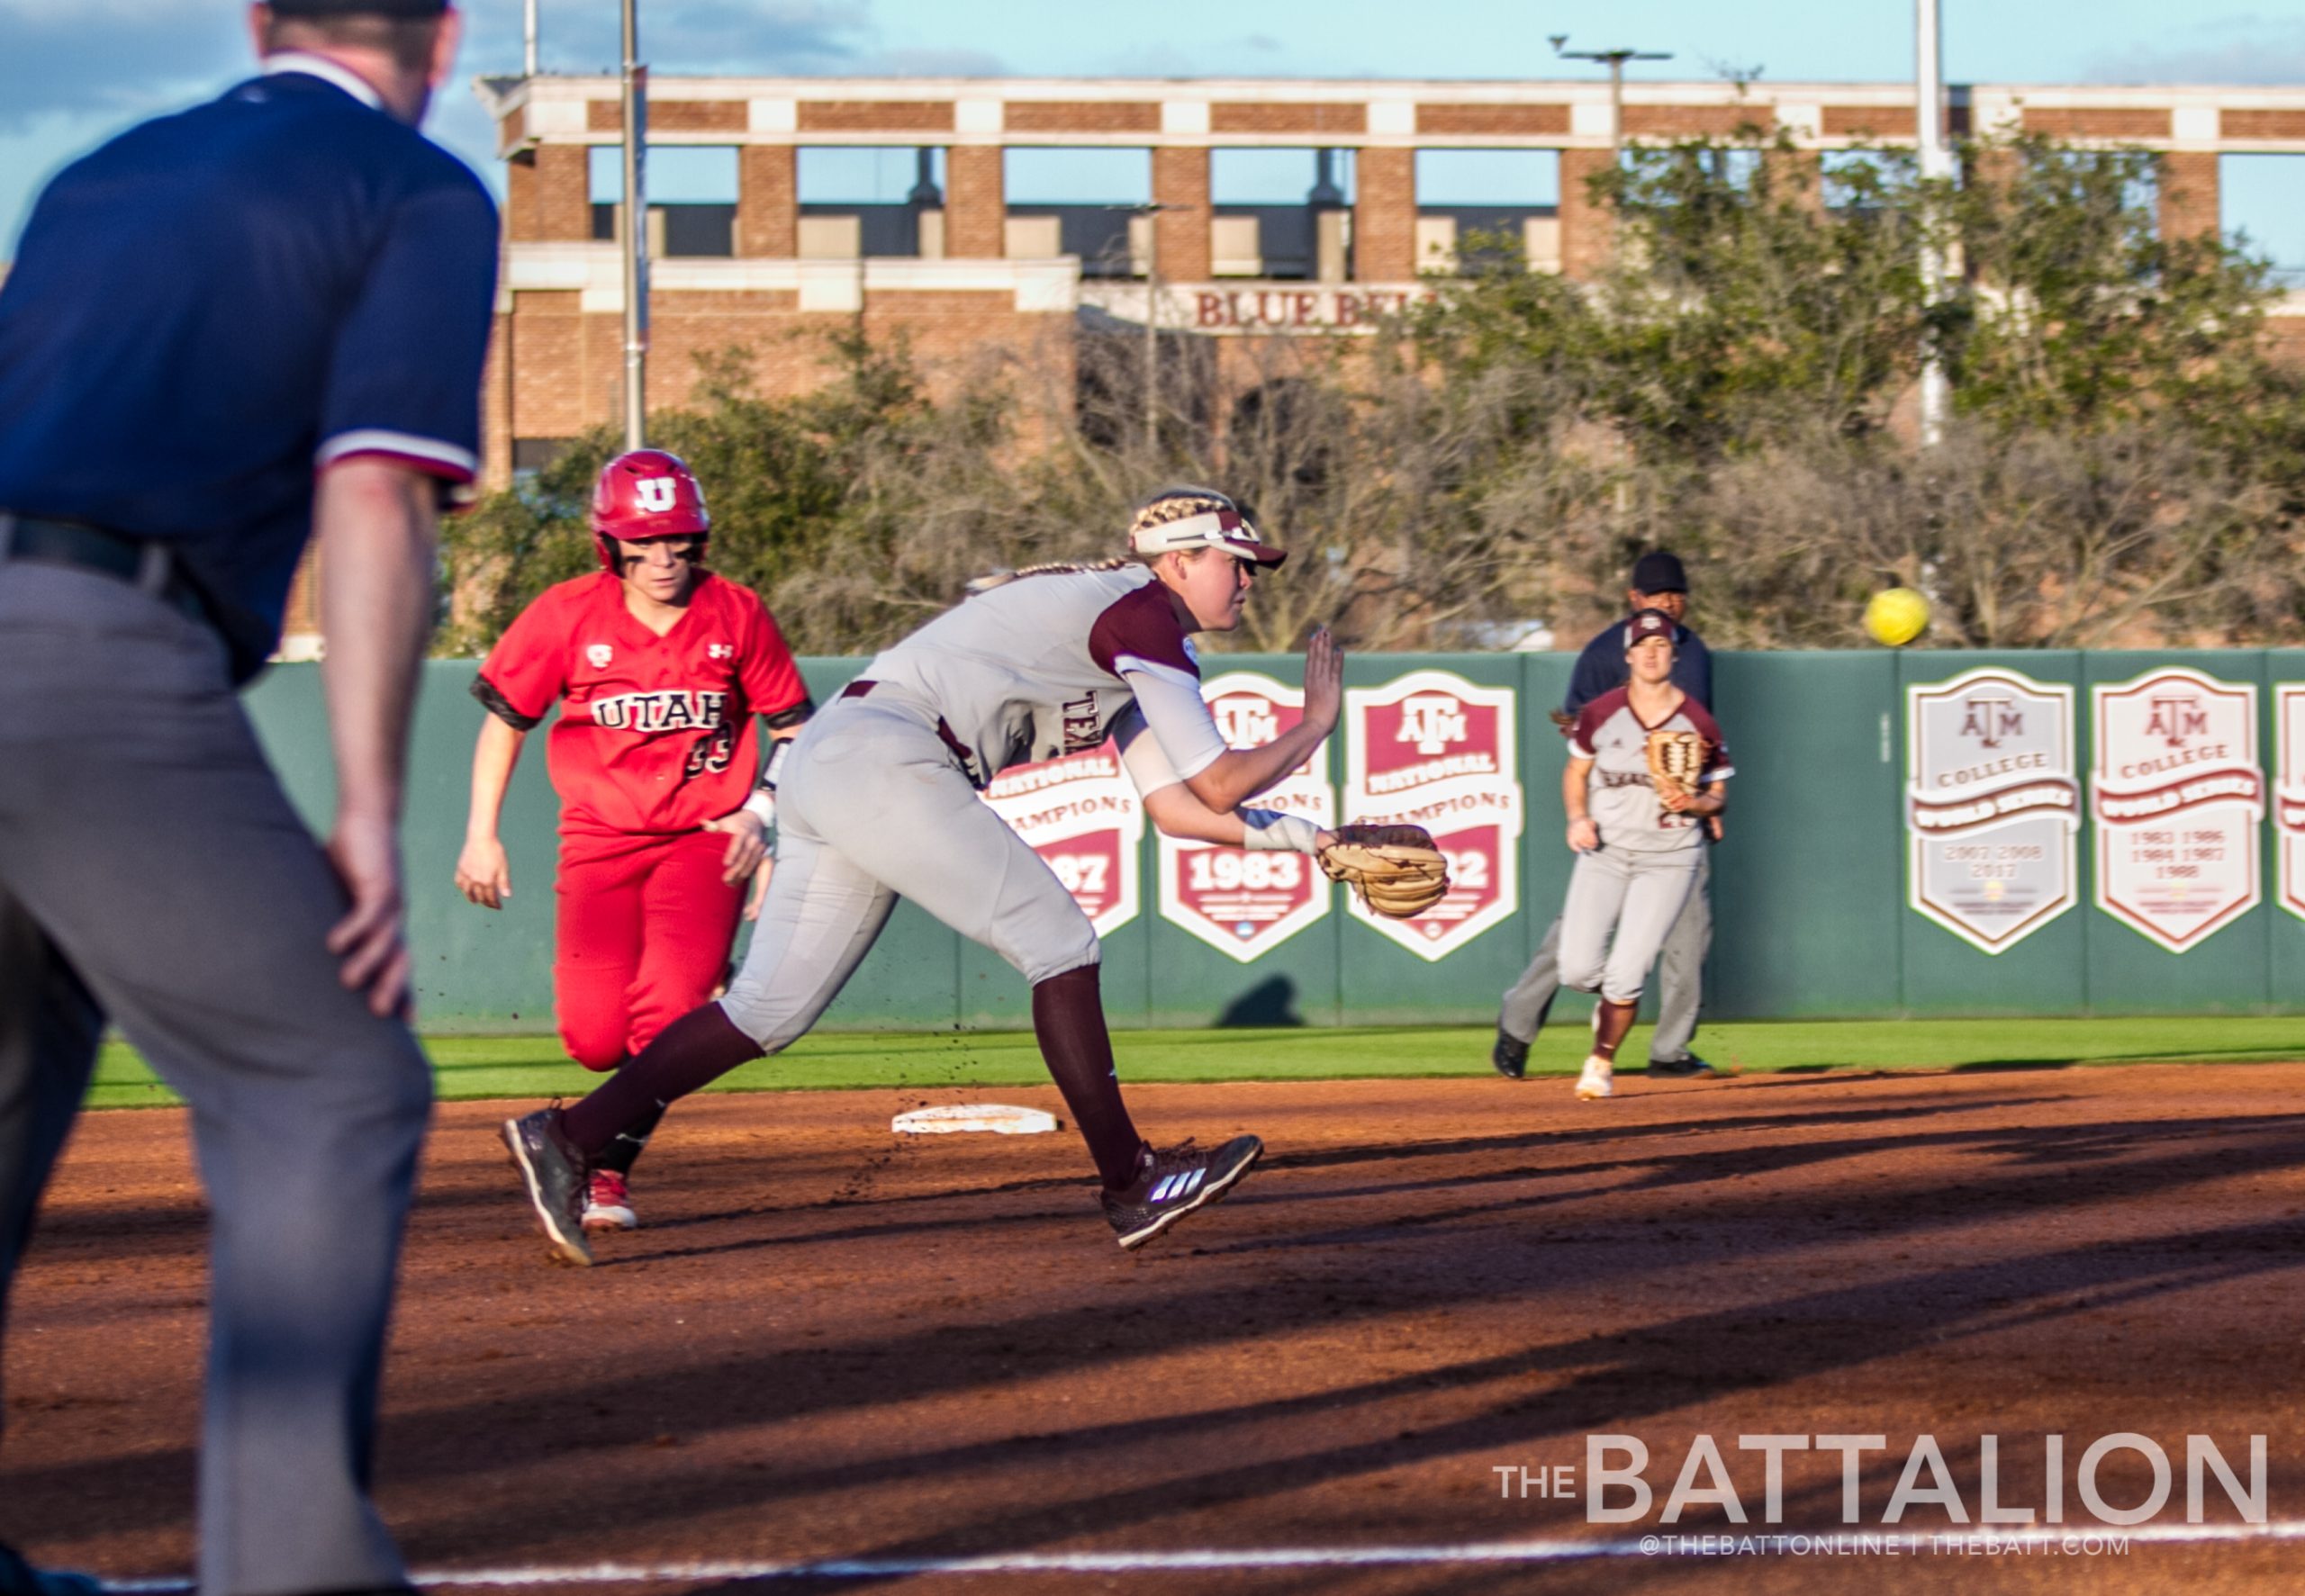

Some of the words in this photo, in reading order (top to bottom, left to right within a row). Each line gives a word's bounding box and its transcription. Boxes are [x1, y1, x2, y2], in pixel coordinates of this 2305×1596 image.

[1197, 292, 1316, 326] BLUE
[634, 477, 677, 512] U
[591, 690, 730, 732] UTAH
[1937, 753, 2047, 788] COLLEGE
[2120, 744, 2229, 780] COLLEGE
[1189, 852, 1302, 890] 1983
